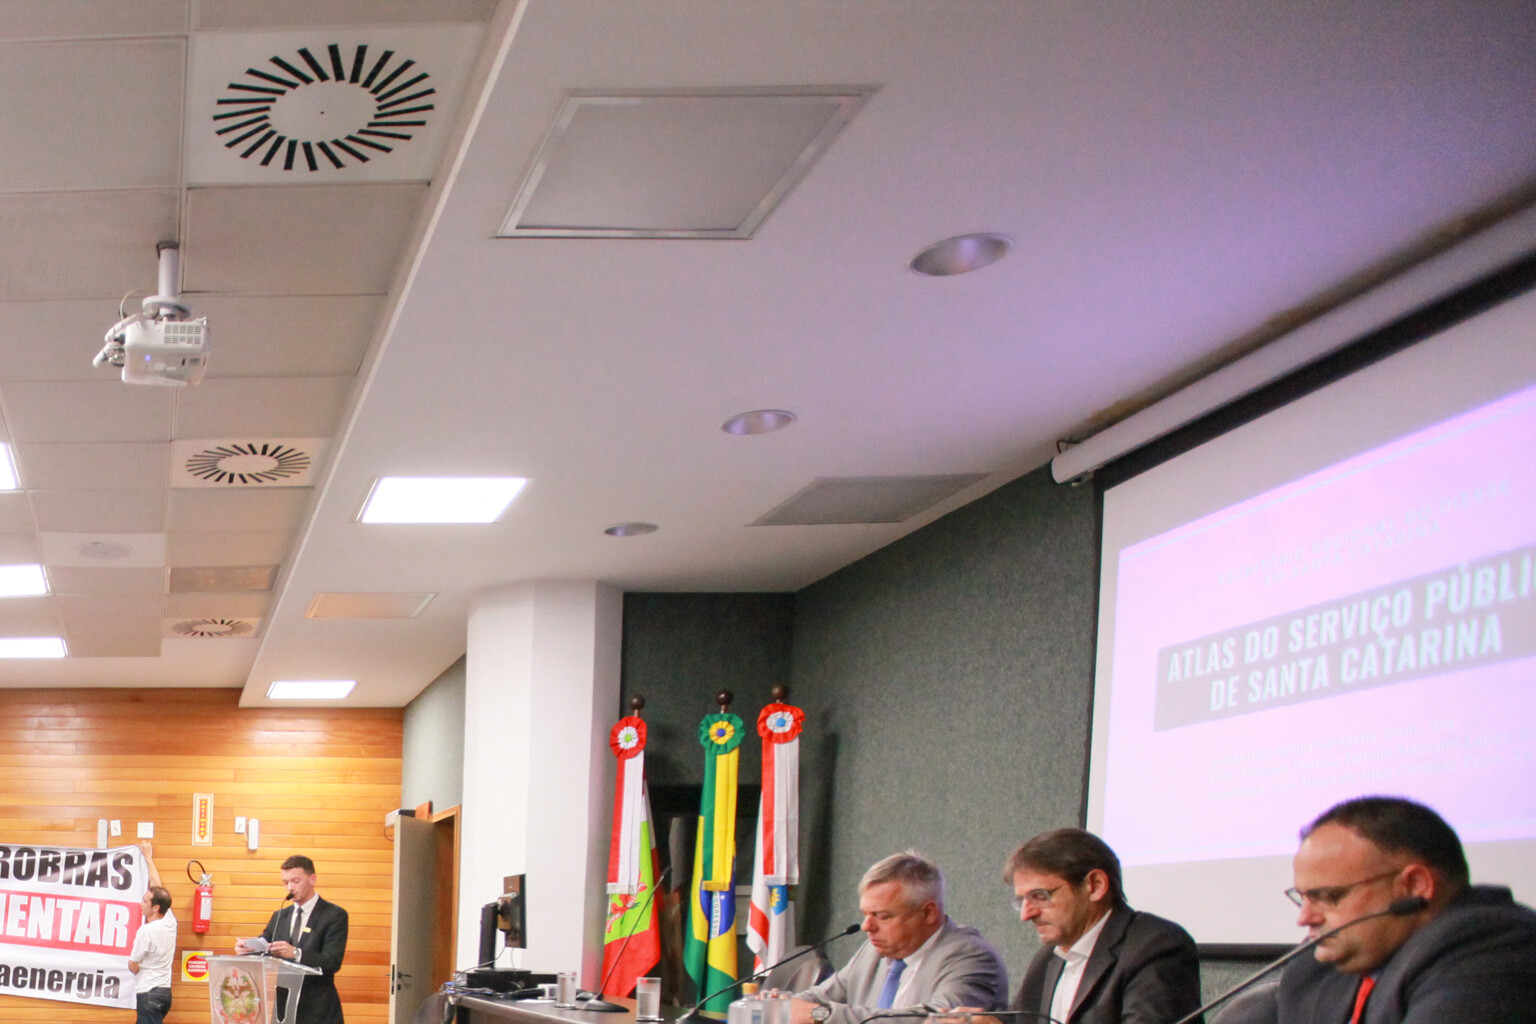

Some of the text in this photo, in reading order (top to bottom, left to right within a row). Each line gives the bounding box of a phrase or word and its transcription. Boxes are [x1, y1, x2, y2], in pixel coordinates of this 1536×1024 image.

[1167, 552, 1536, 684] ATLAS DO SERVIÇO PÚBLI
[1209, 612, 1502, 712] DE SANTA CATARINA
